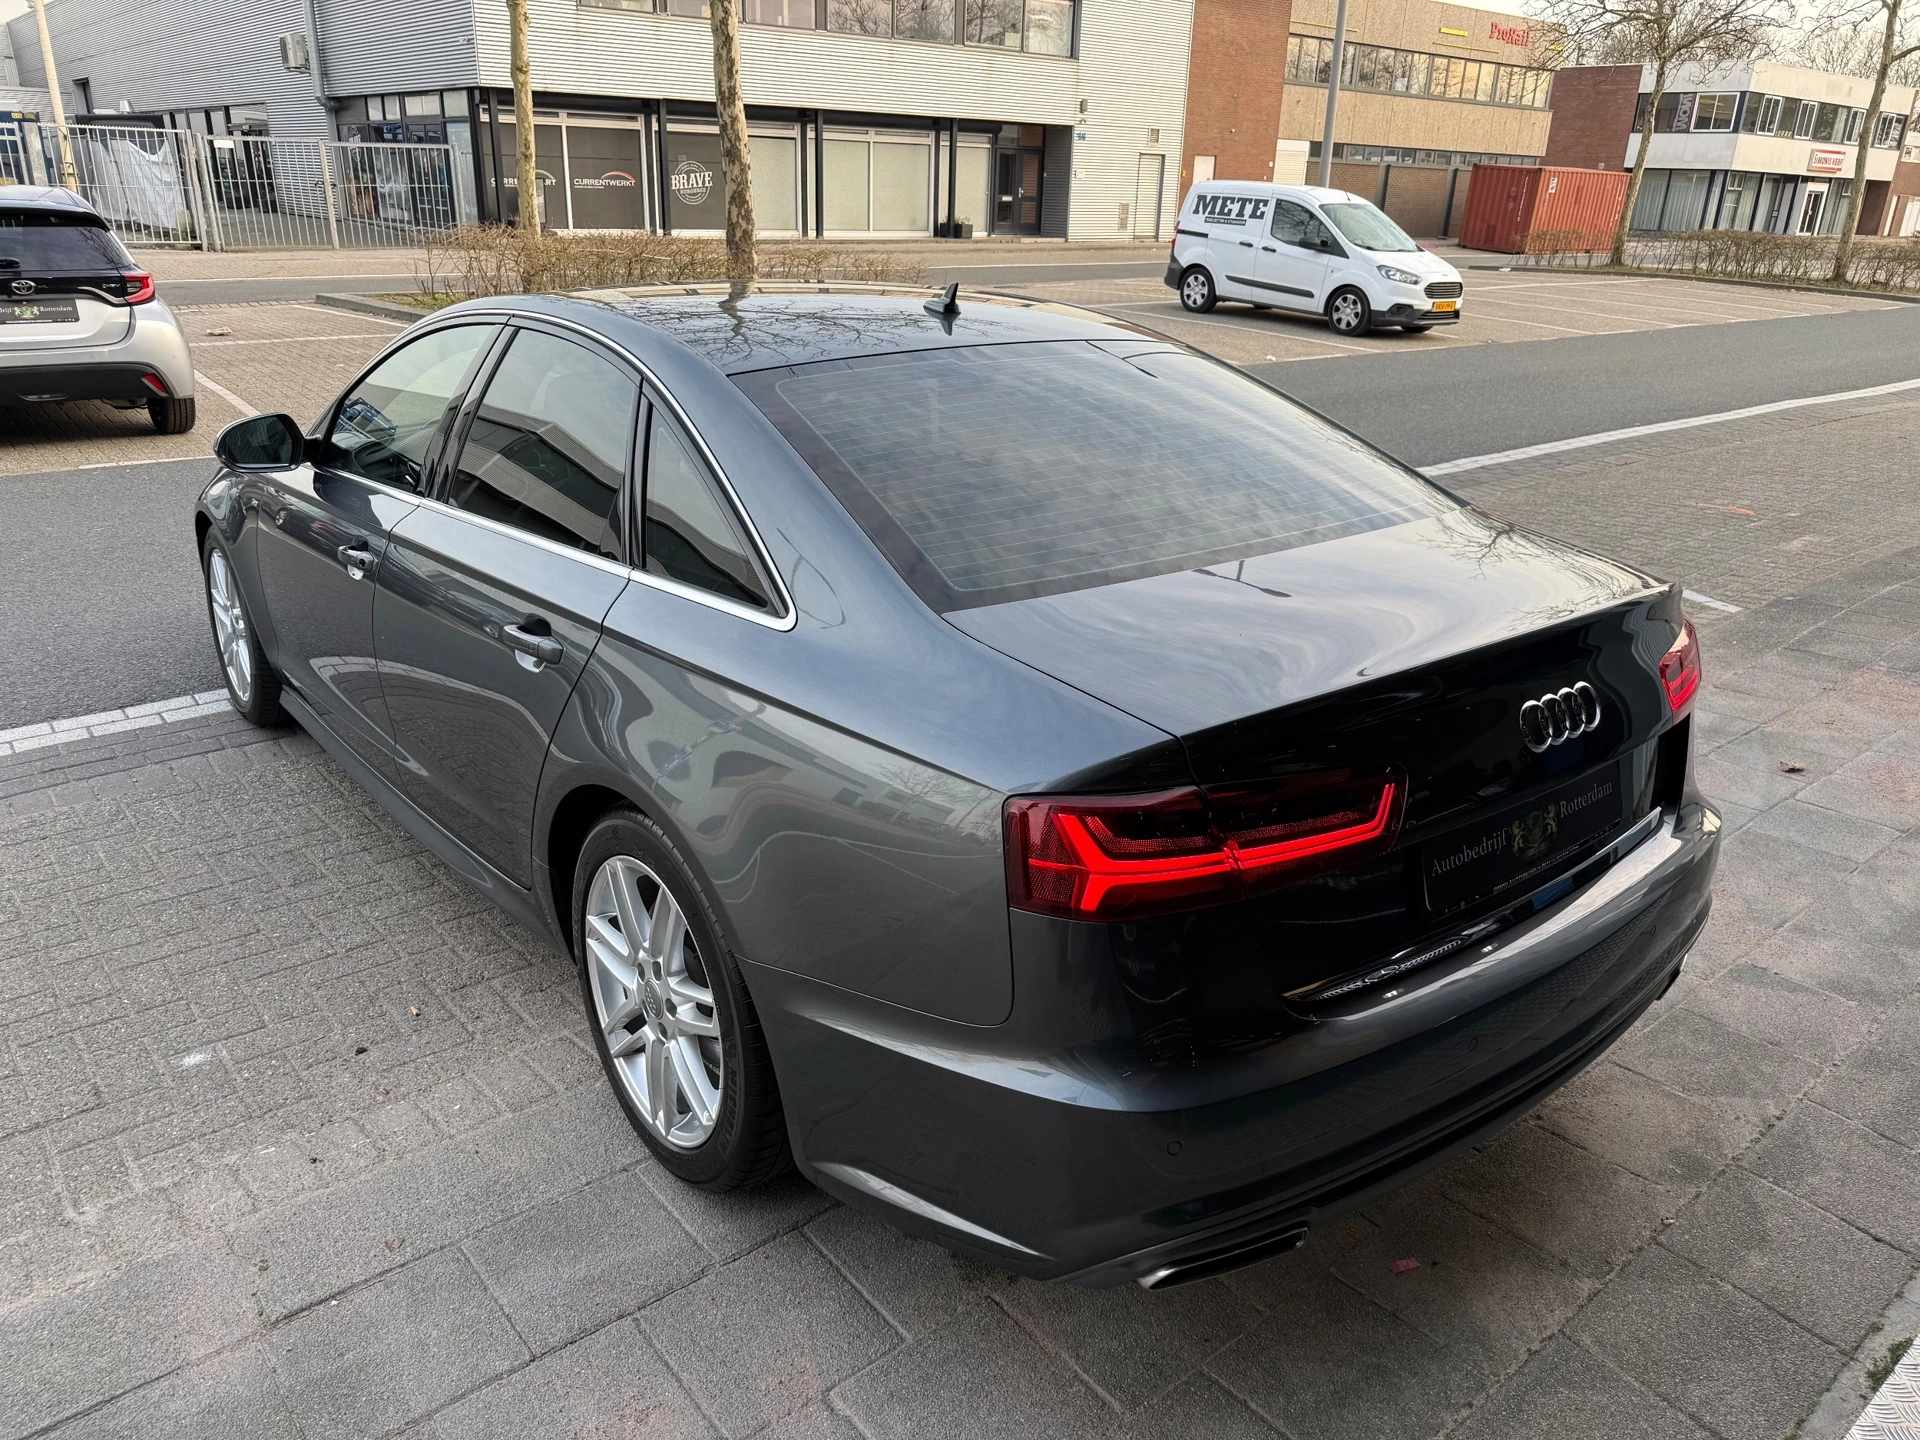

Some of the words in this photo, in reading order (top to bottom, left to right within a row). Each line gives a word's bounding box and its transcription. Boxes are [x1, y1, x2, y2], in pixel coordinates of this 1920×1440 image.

[1489, 22, 1531, 47] ProRail
[574, 178, 636, 187] CURRENTWERKT
[671, 172, 713, 190] BRAVE
[1192, 195, 1269, 219] METE
[1431, 827, 1508, 877] Autobedrijf
[1559, 781, 1613, 818] Rotterdam
